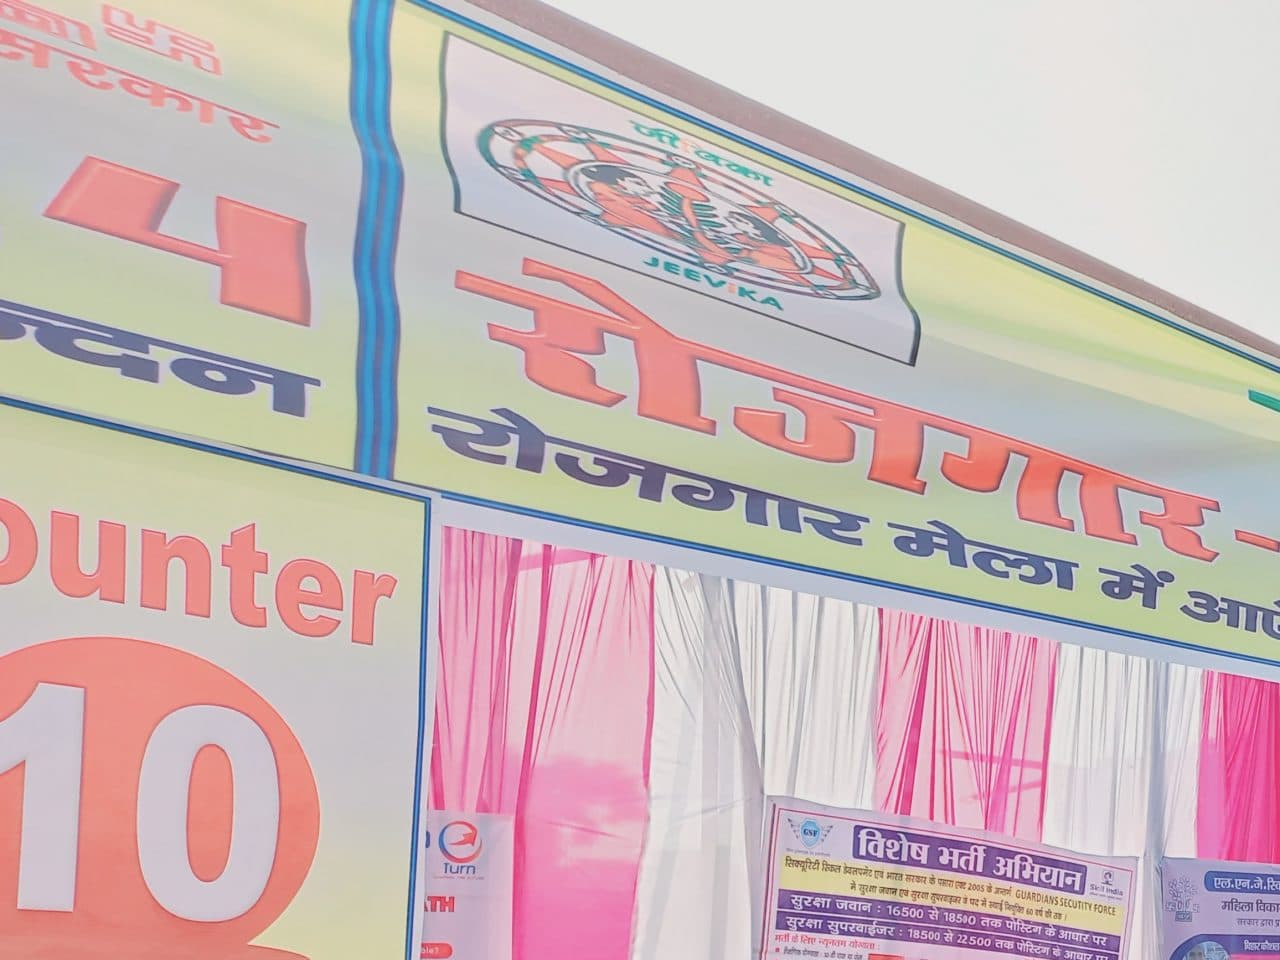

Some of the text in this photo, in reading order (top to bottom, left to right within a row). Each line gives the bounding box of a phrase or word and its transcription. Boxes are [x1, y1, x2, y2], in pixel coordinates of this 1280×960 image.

[427, 406, 870, 550] रोजगार
[887, 518, 1078, 592] मेला
[1101, 563, 1175, 610] में
[0, 681, 281, 924] 10
[443, 862, 476, 875] Turn
[858, 828, 1083, 892] विशेष भर्ती अभियान
[790, 894, 832, 911] सुरक्षा
[836, 898, 873, 913] जवान
[886, 904, 924, 919] 16500
[927, 906, 939, 921] से
[980, 917, 1002, 928] तक
[1005, 916, 1042, 935] पोस्टिंग
[1044, 922, 1056, 937] के
[1092, 936, 1108, 947] पर
[967, 882, 985, 892] 2005
[1015, 889, 1059, 906] GUARDIANS
[1093, 903, 1116, 916] FORCE
[1221, 898, 1254, 912] महिला
[785, 915, 823, 930] सुरक्षा
[827, 919, 896, 936] सुपरवाईजर
[907, 928, 940, 942] 18500
[943, 930, 953, 943] से
[956, 934, 991, 947] 22500
[994, 939, 1014, 949] तक
[1016, 939, 1050, 956] पोस्टिंग
[1052, 945, 1062, 958] के
